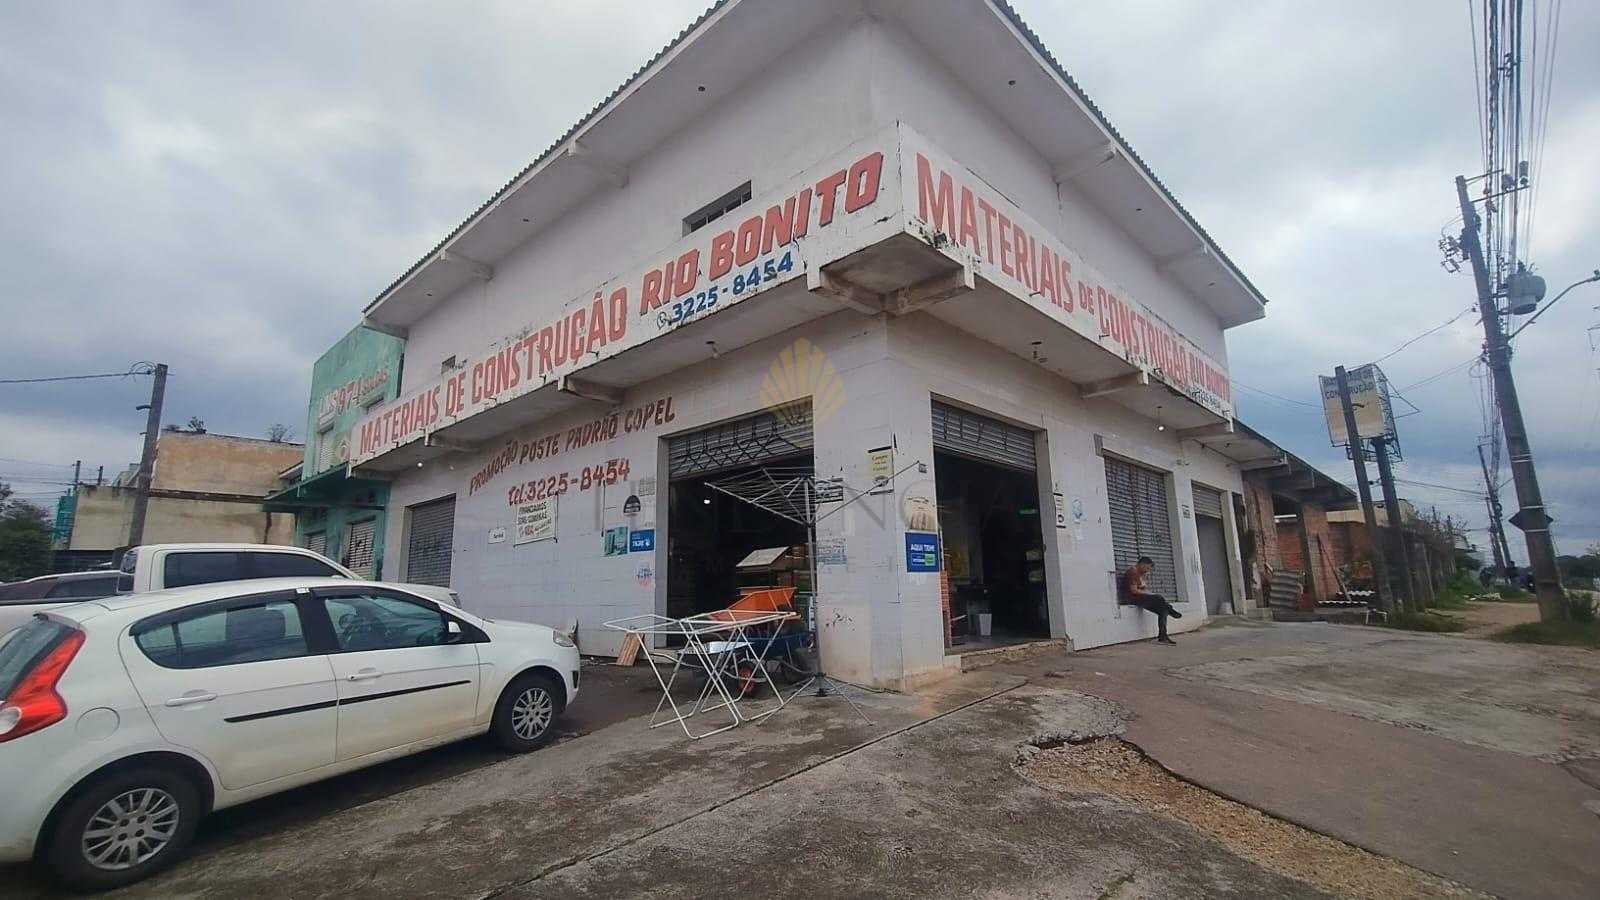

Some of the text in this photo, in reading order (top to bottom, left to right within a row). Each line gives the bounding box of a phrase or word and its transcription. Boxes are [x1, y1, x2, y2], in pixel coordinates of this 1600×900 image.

[360, 385, 440, 455] MATERIAIS
[445, 371, 466, 417] DE
[470, 285, 628, 406] CONSTRUÇÃO
[640, 248, 702, 316] RIO
[708, 151, 884, 282] BONITO
[915, 152, 1075, 314] MATERIAIS
[1078, 281, 1095, 315] DE
[469, 395, 676, 496] PROMOÇÃO POSTE PADRÃO COPEL
